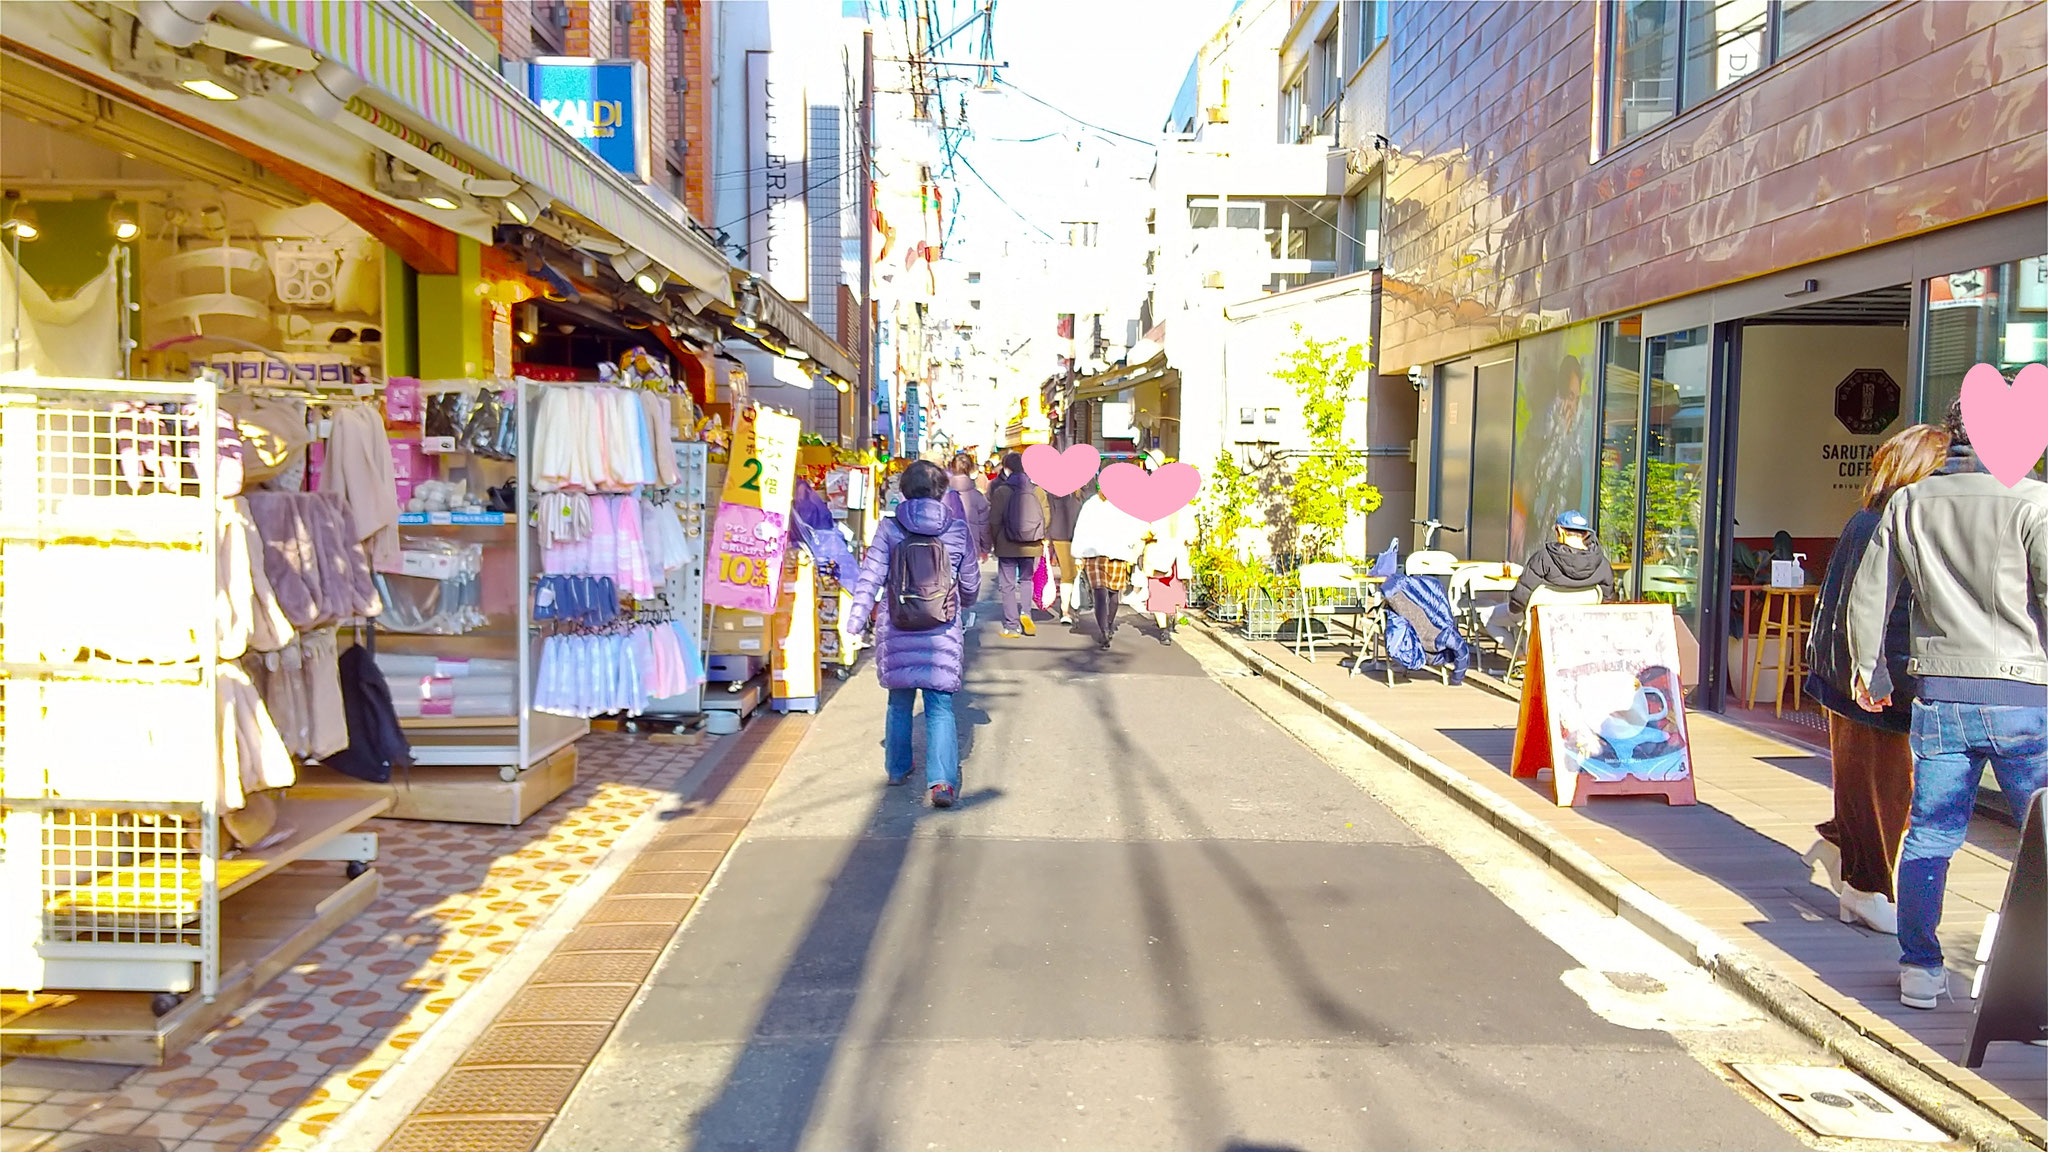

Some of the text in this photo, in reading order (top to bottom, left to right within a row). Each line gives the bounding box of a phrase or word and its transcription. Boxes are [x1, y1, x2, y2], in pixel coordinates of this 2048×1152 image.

[540, 99, 622, 128] KALDI
[1822, 444, 1880, 460] SARUTA
[1839, 462, 1872, 477] COFF
